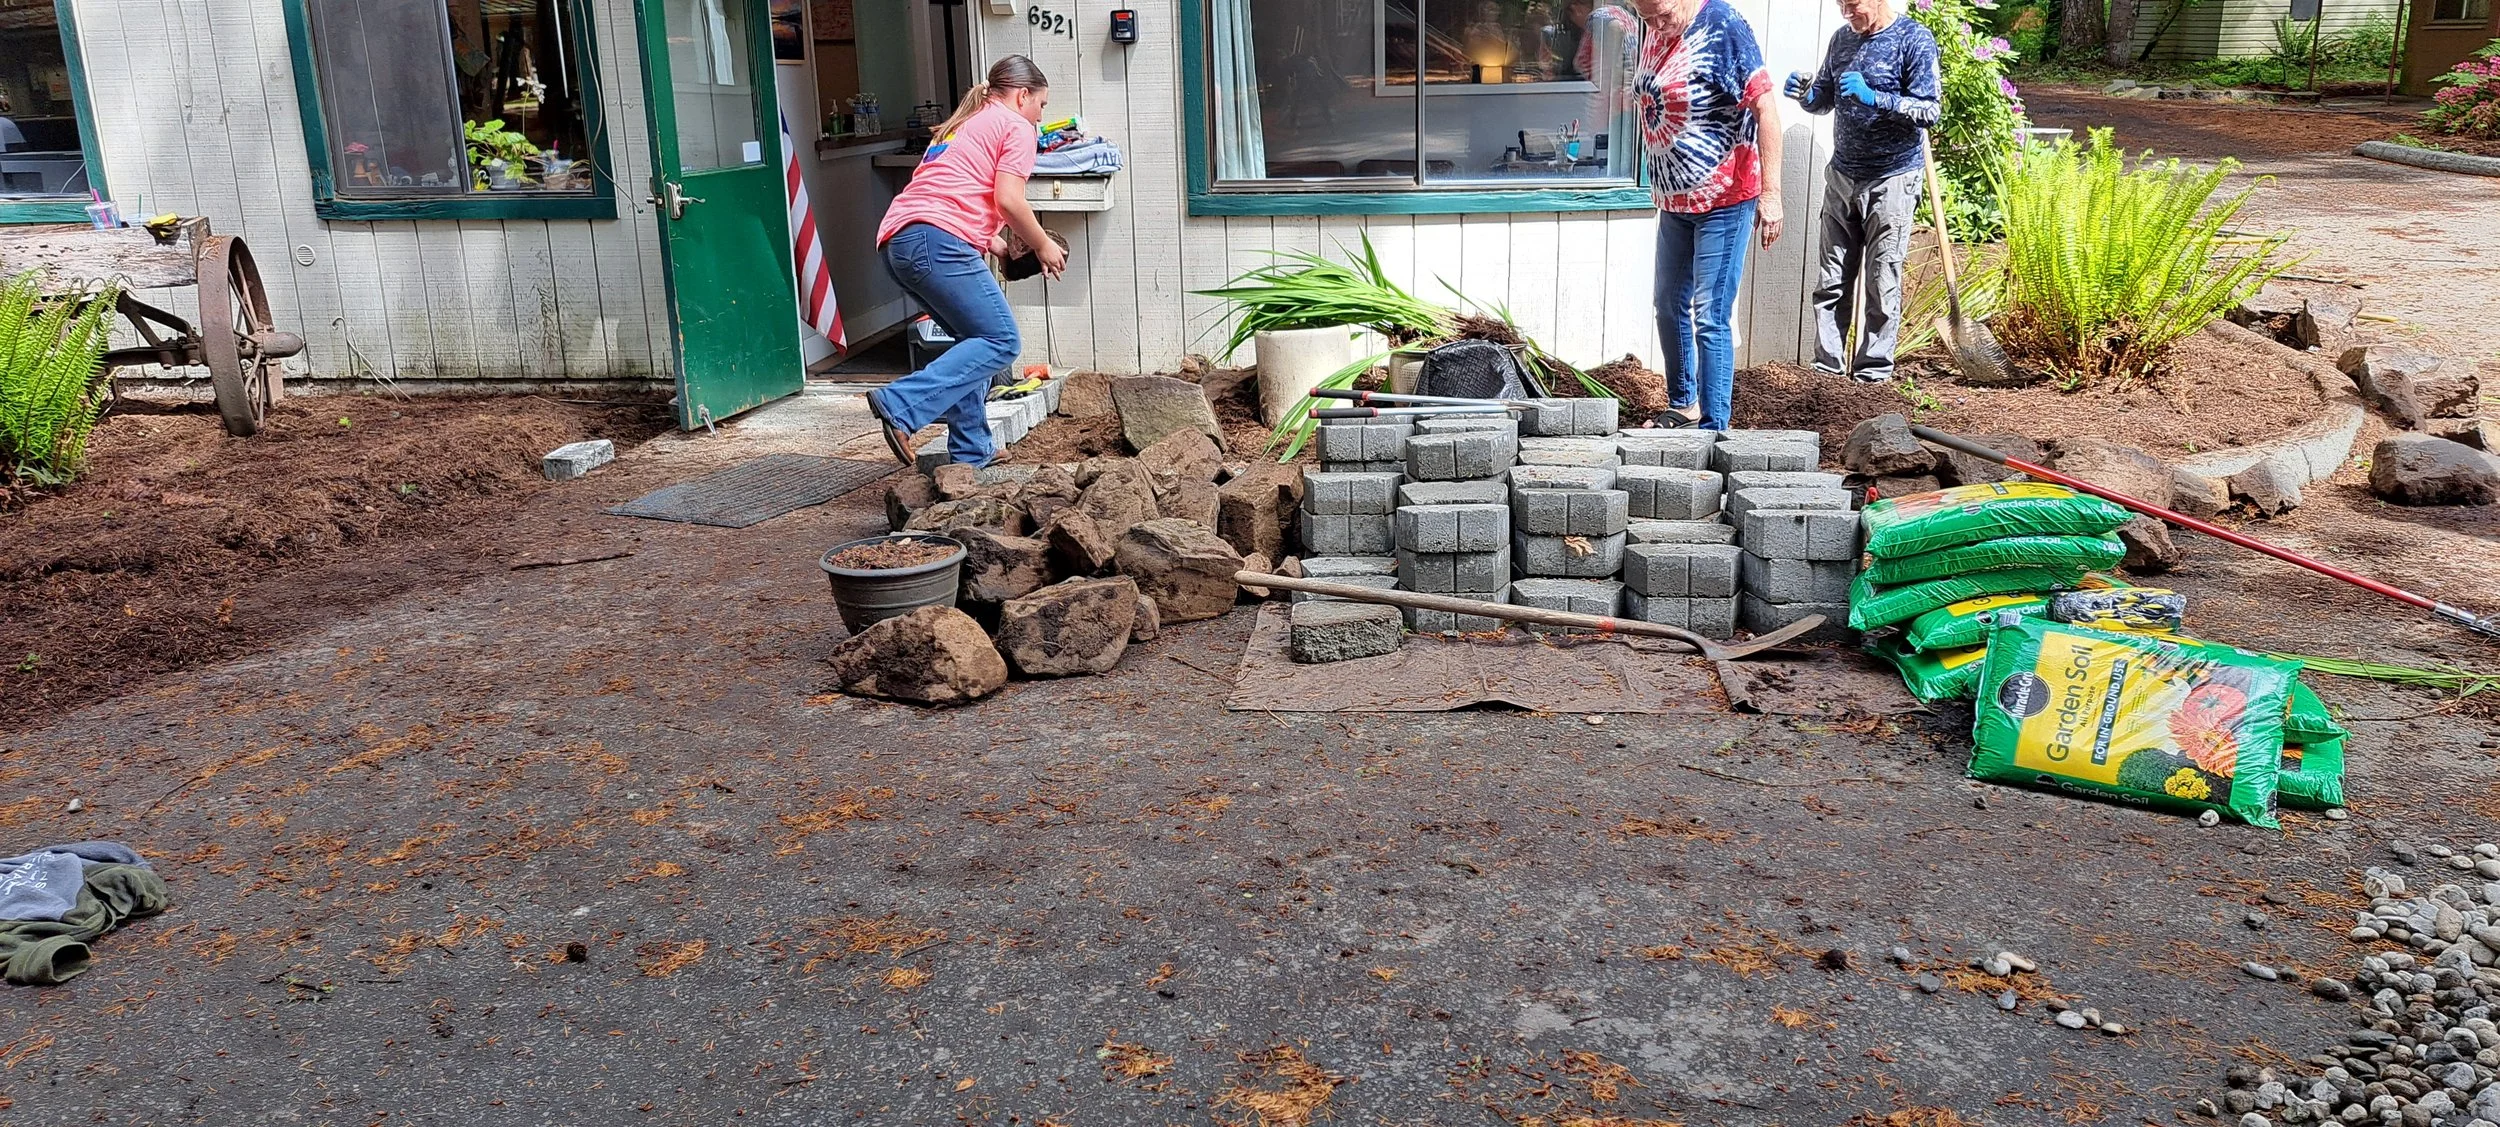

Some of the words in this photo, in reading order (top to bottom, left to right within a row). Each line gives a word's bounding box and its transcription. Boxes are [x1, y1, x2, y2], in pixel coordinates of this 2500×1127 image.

[1028, 5, 1074, 39] 6521
[1092, 152, 1120, 168] AVY
[1985, 499, 2034, 510] Garden
[2036, 498, 2061, 508] Soil
[2112, 662, 2126, 680] USE
[2046, 682, 2084, 762] Garden
[2065, 644, 2093, 682] Soil
[2082, 685, 2096, 715] Purpose
[2099, 683, 2120, 738] IN-GROUND
[2079, 716, 2088, 727] All
[2094, 740, 2108, 760] FOR
[2061, 782, 2118, 799] Garden
[2121, 793, 2149, 805] Soil
